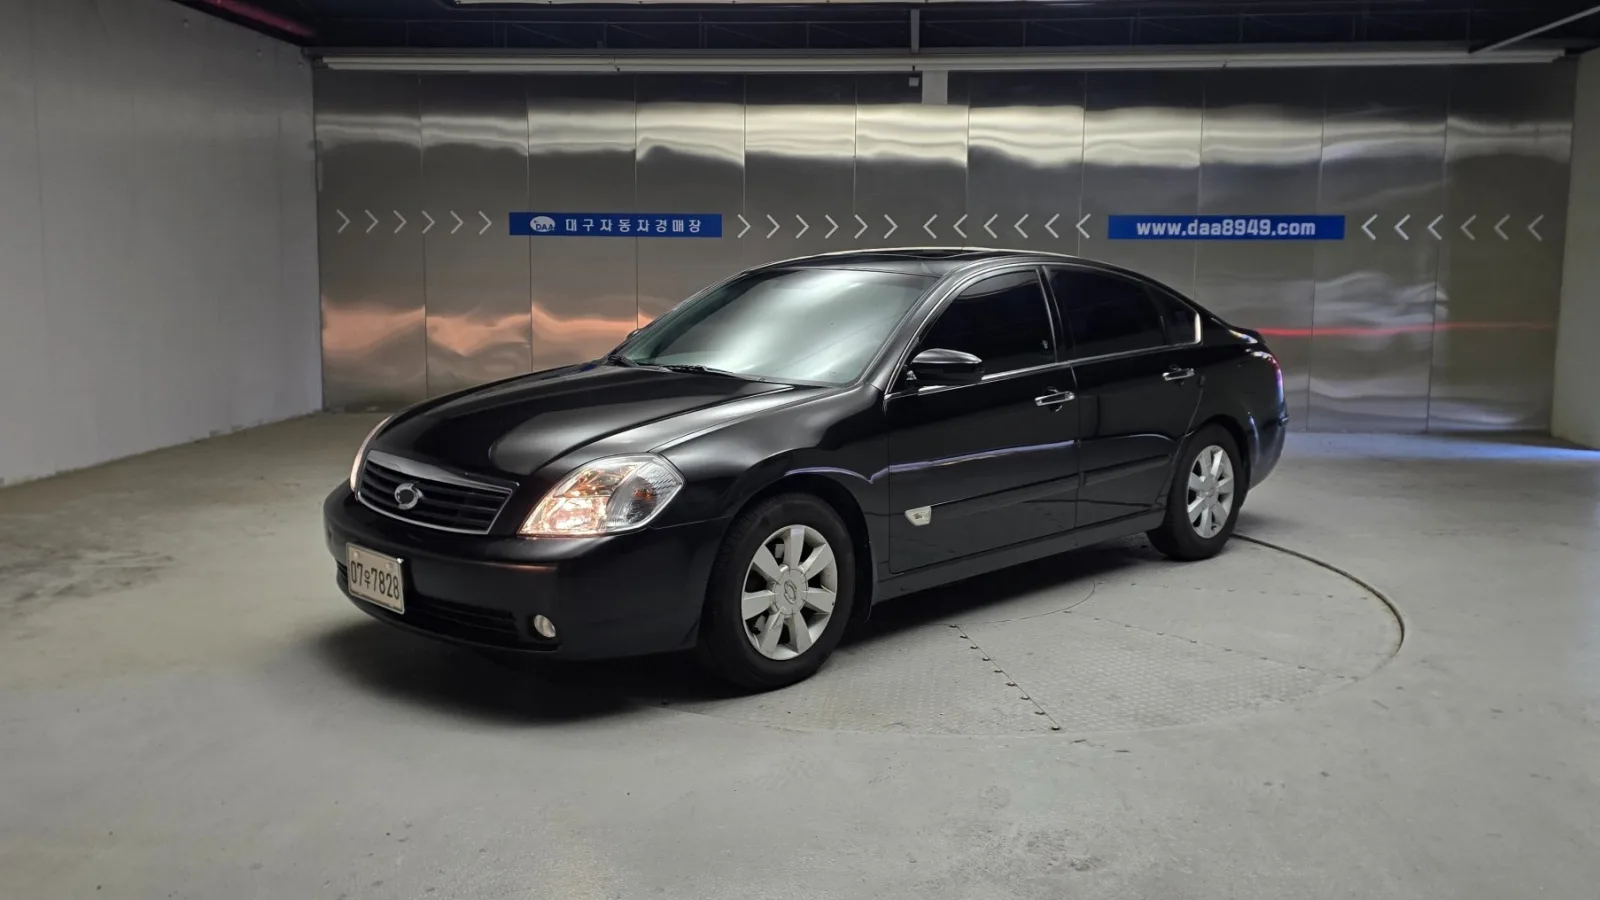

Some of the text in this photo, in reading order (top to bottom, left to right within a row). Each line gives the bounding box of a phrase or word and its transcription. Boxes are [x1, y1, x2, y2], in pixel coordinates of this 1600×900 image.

[535, 223, 555, 231] DAA
[1136, 219, 1316, 236] www.daa8949.com
[350, 560, 400, 600] 07우7828
